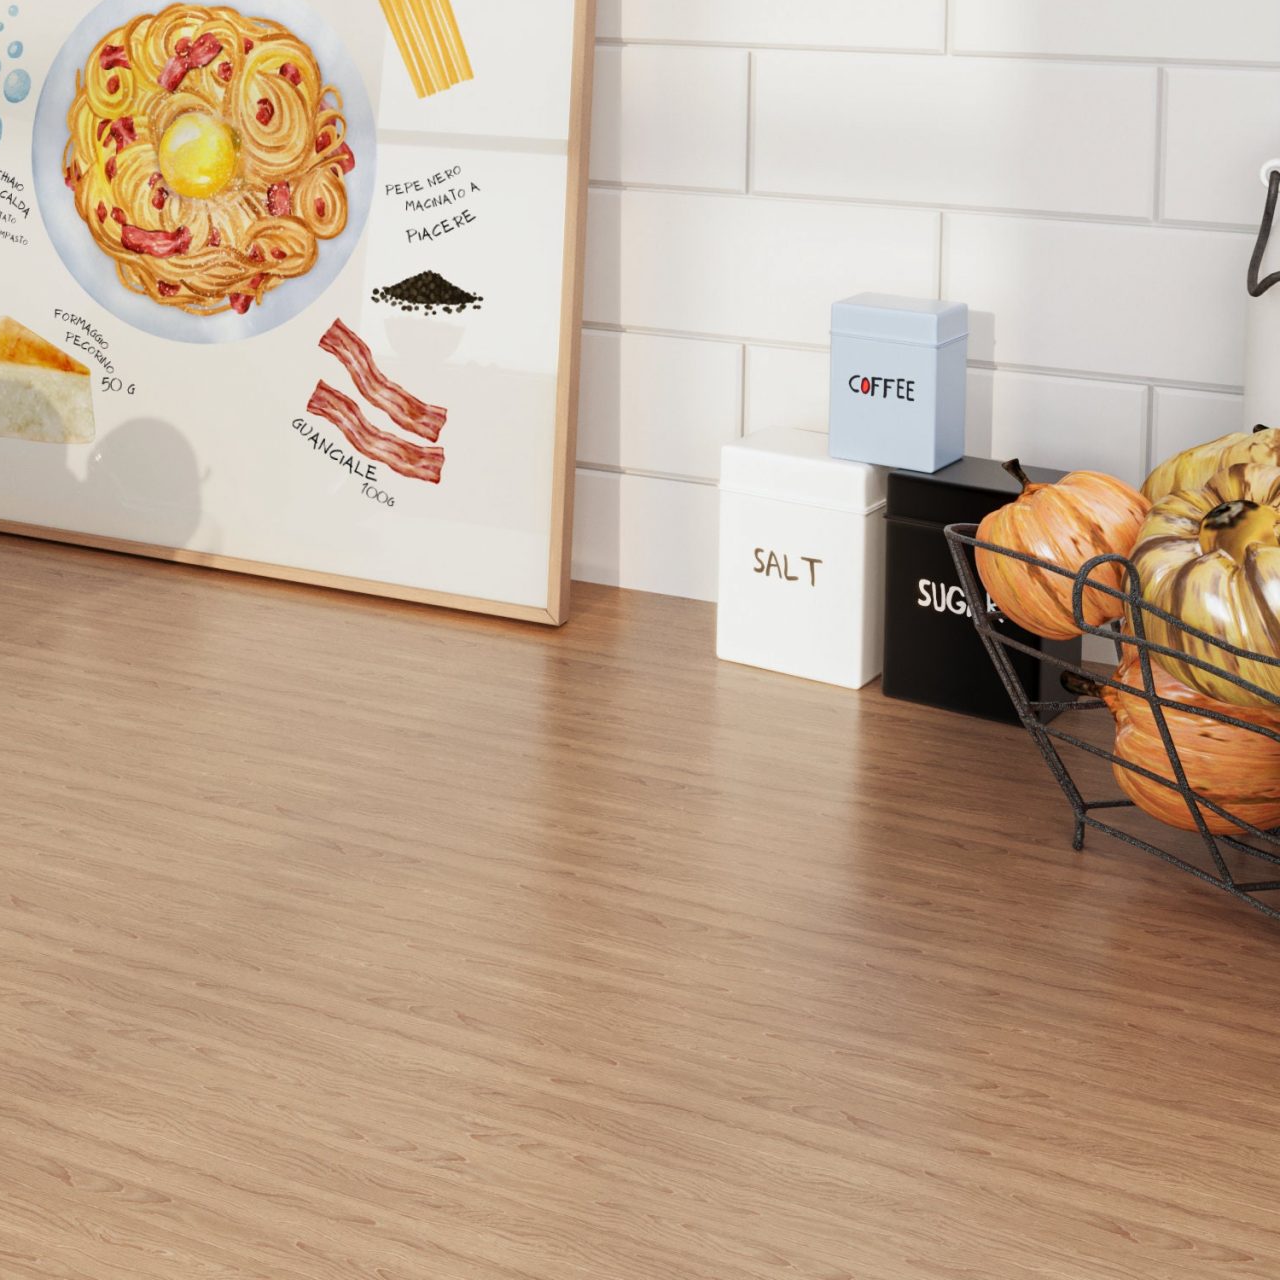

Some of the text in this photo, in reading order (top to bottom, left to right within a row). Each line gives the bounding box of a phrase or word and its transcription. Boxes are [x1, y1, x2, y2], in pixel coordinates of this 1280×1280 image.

[385, 165, 461, 195] PEPE NERO
[0, 190, 30, 219] CALDA
[405, 182, 480, 211] MACINATO A
[406, 209, 476, 243] PIACERE
[54, 308, 109, 349] FORMAGGIO
[65, 331, 114, 374] PECORINO
[101, 376, 136, 395] 50 G
[848, 374, 916, 402] COFFEE
[292, 418, 377, 482] GUANCIALE
[361, 482, 395, 507] 100G
[753, 547, 823, 586] SALT
